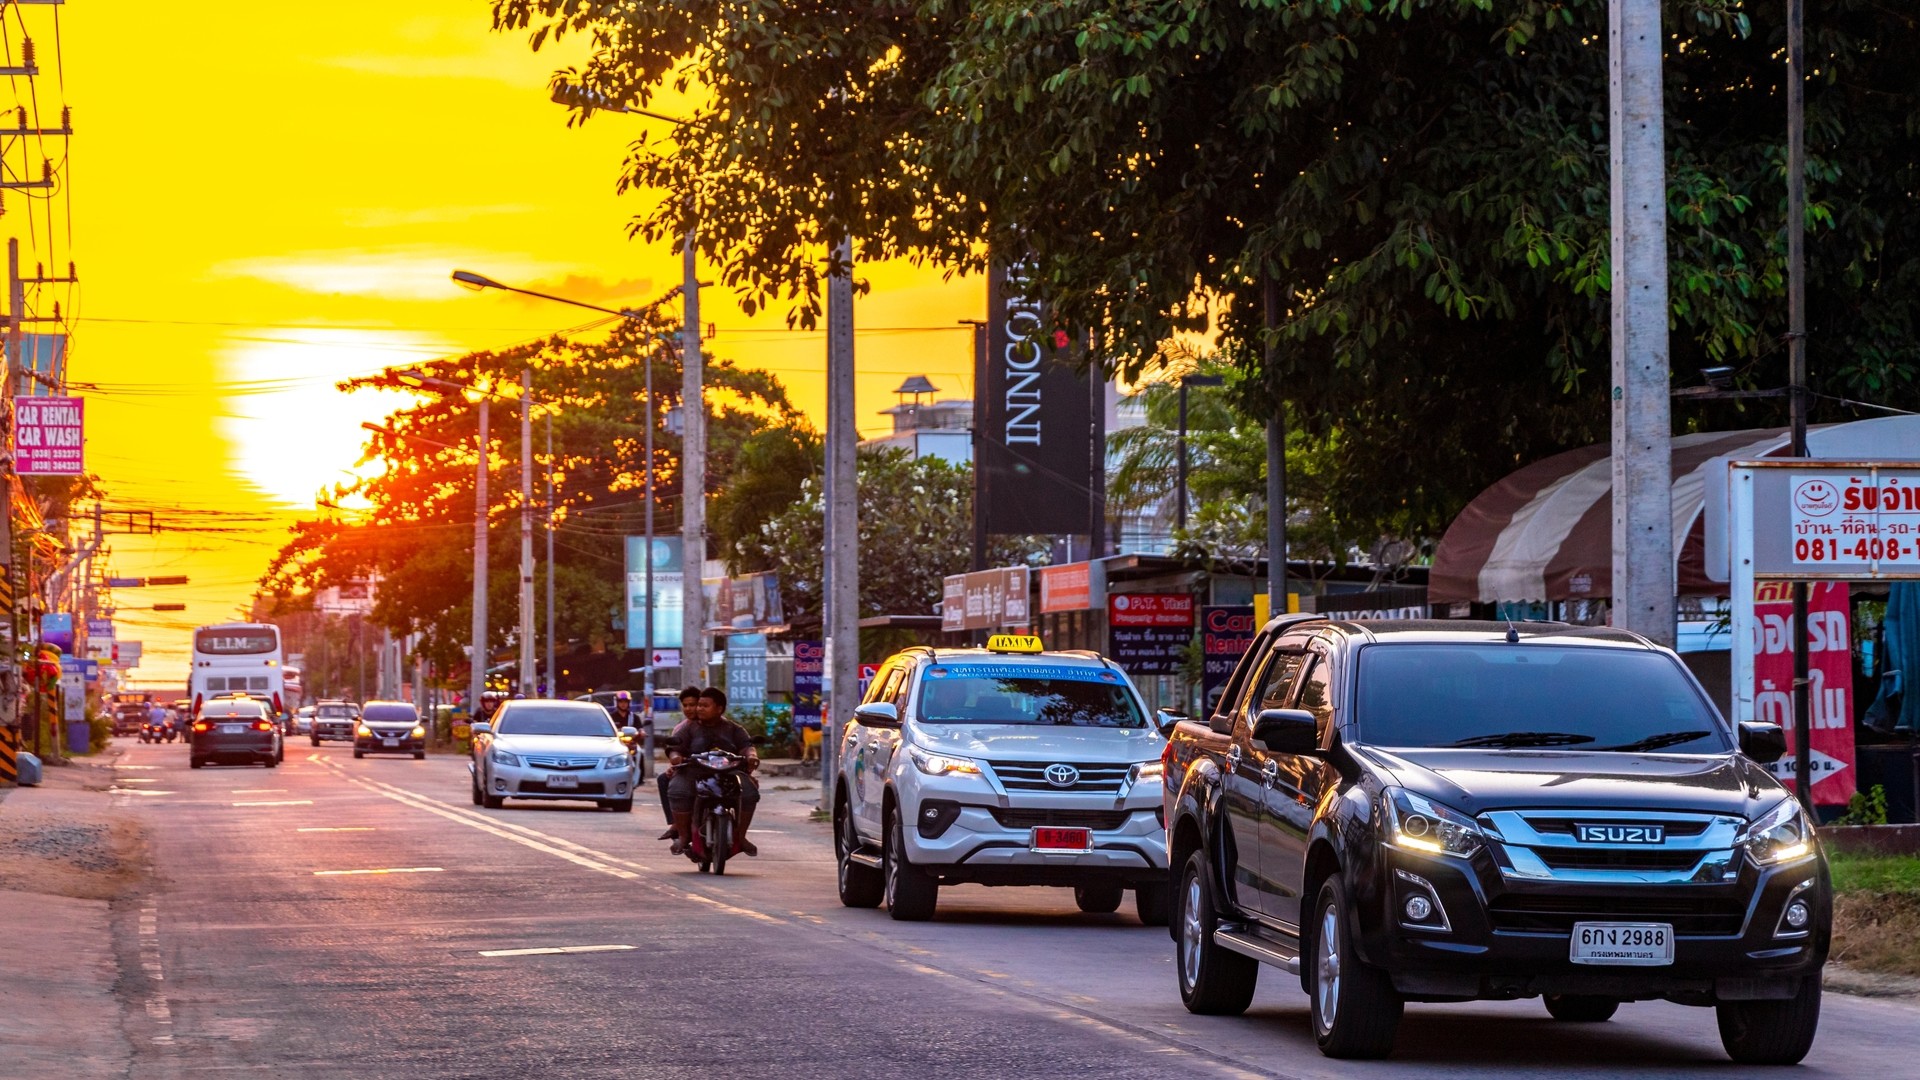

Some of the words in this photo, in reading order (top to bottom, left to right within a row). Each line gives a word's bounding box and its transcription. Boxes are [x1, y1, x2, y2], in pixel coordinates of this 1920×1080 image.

[17, 405, 38, 425] CAR
[41, 406, 81, 425] RENTAL
[17, 427, 41, 446] CAR
[44, 427, 80, 447] WASH
[1131, 597, 1157, 610] P.T.
[1161, 597, 1191, 610] Thai
[1207, 609, 1256, 632] Car
[734, 653, 760, 666] BUY
[732, 670, 762, 682] SELL
[730, 686, 764, 699] RENT
[1580, 827, 1662, 842] ISUZU
[1622, 930, 1665, 946] 2988
